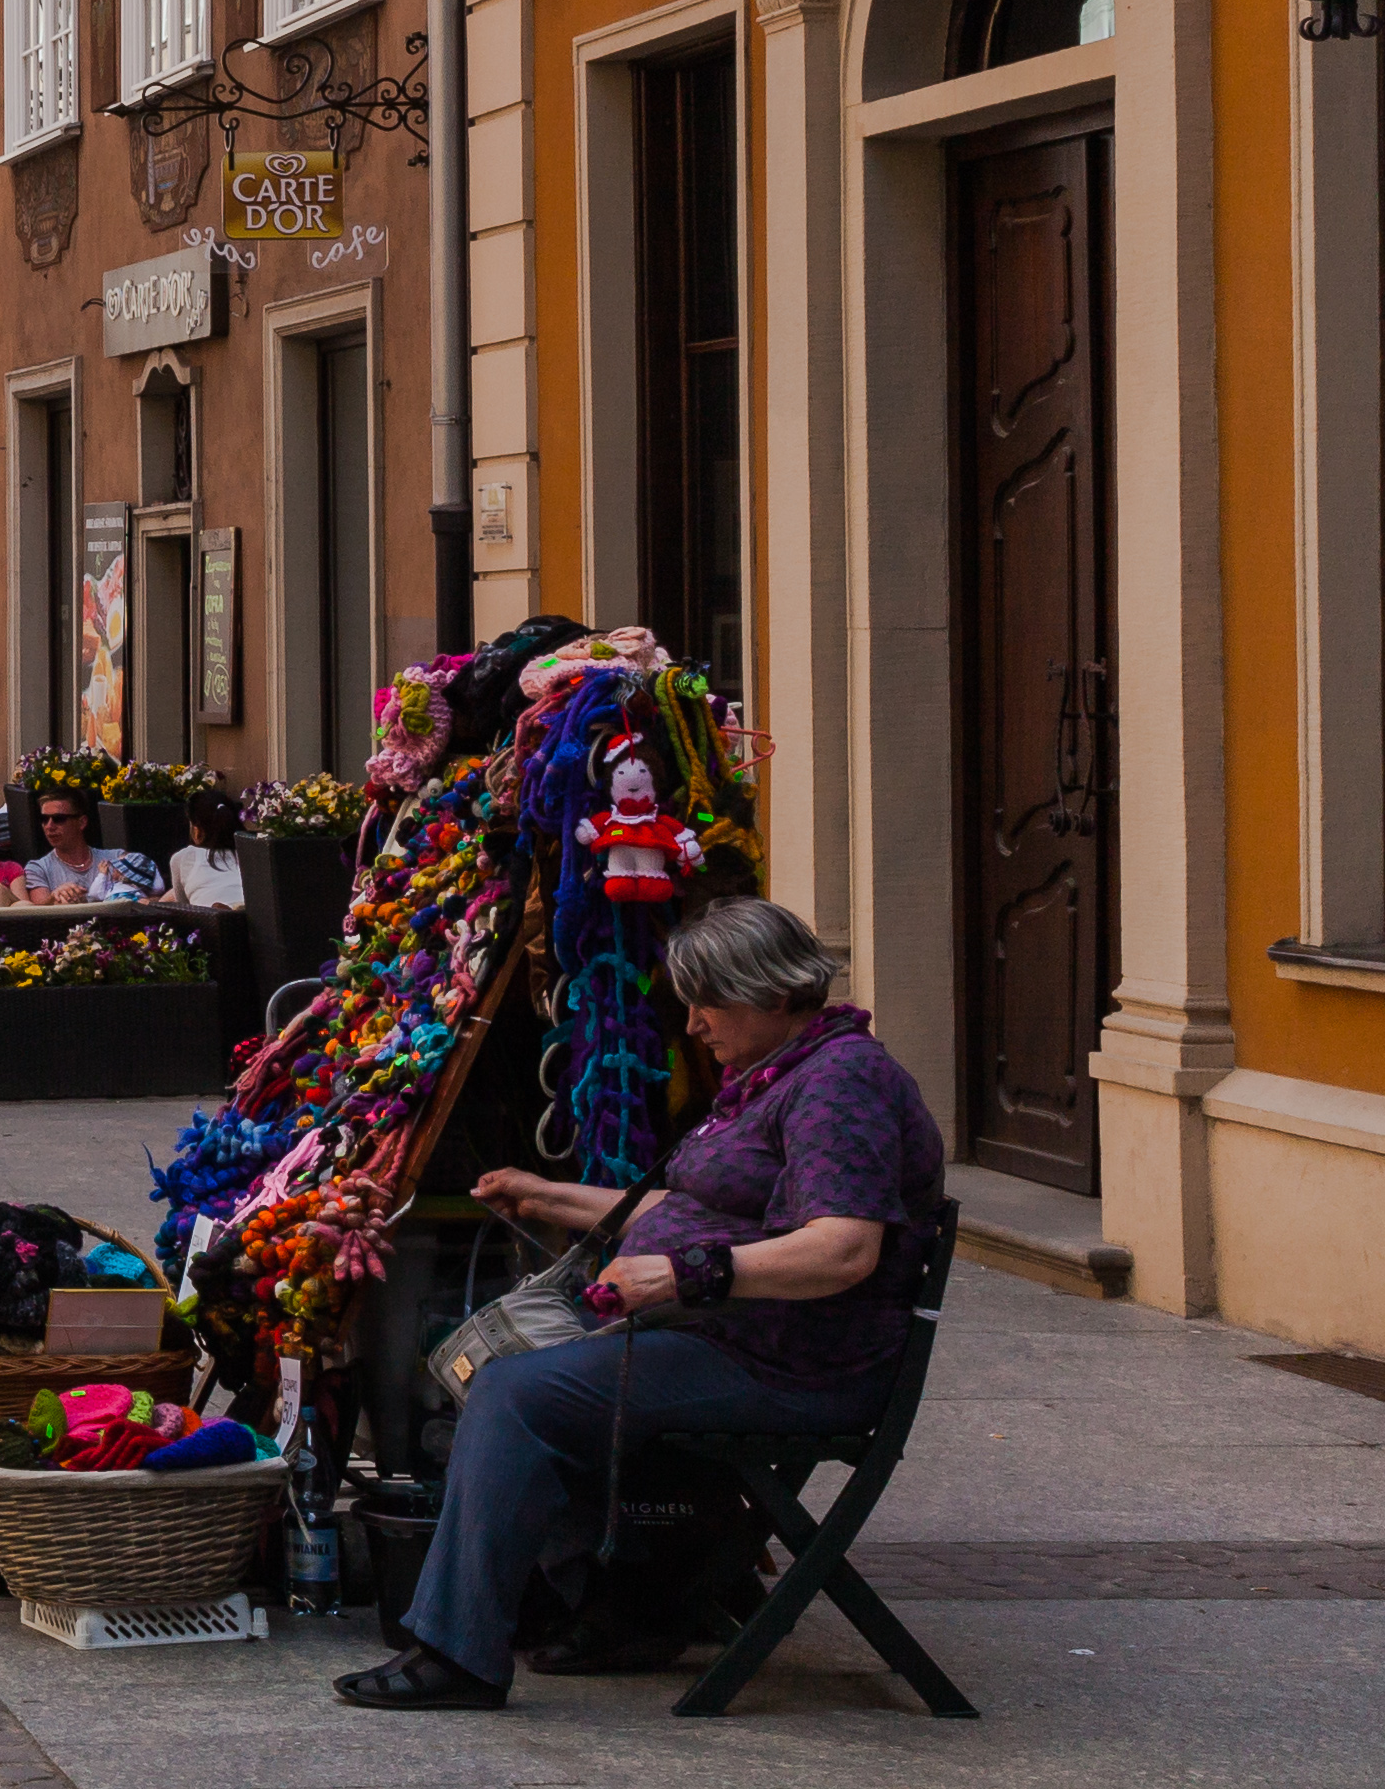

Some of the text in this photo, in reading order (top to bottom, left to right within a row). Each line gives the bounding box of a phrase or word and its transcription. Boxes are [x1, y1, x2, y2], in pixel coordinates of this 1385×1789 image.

[232, 173, 335, 207] CARTE
[245, 201, 331, 235] D'OR
[121, 275, 159, 325] CARTE
